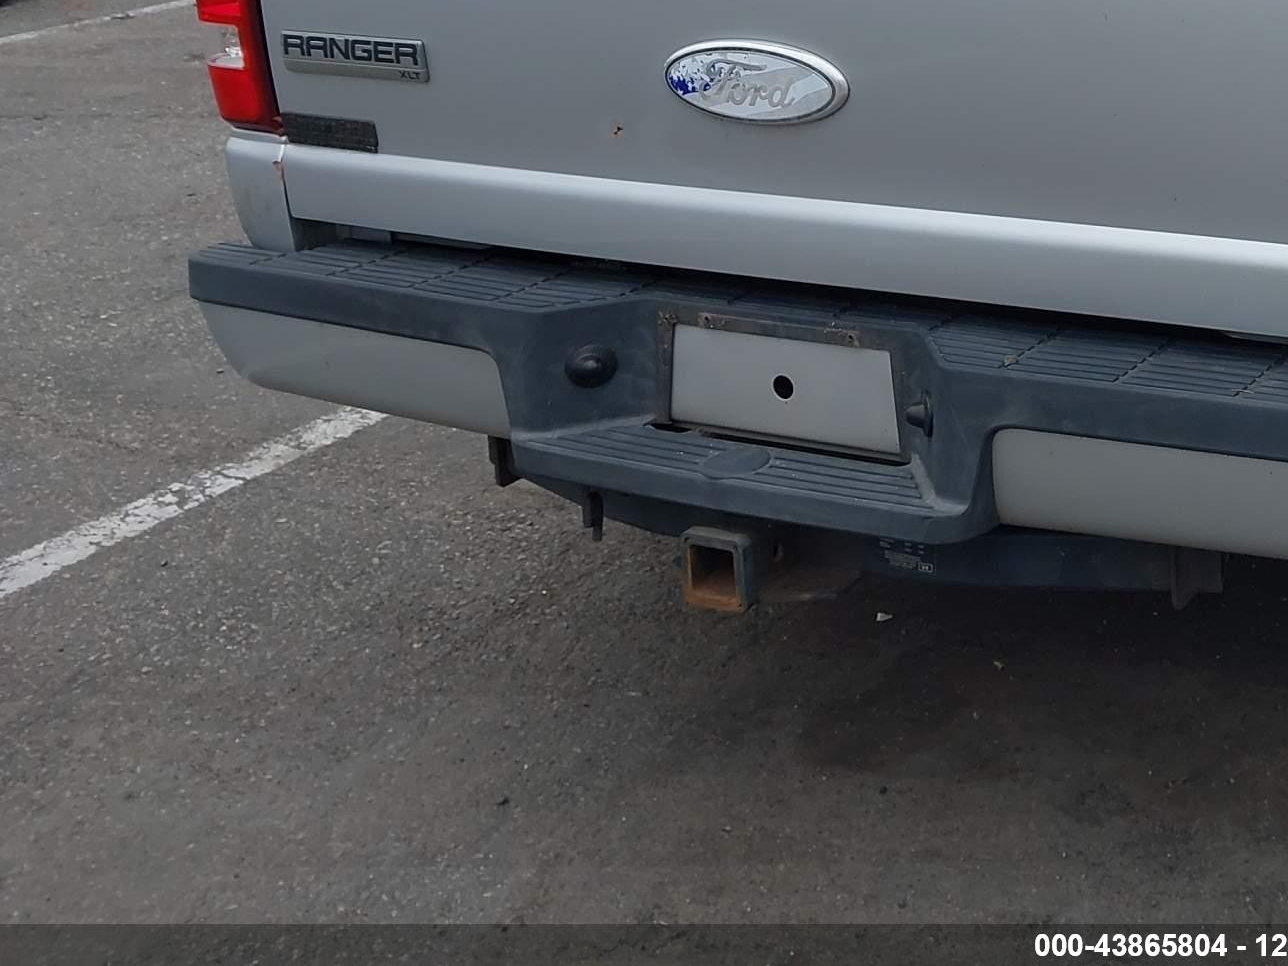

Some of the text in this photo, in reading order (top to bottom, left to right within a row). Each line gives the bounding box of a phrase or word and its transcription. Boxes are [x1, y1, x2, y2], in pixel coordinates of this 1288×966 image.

[283, 34, 419, 65] RANGER
[399, 70, 420, 80] XLT
[701, 58, 794, 108] Ford
